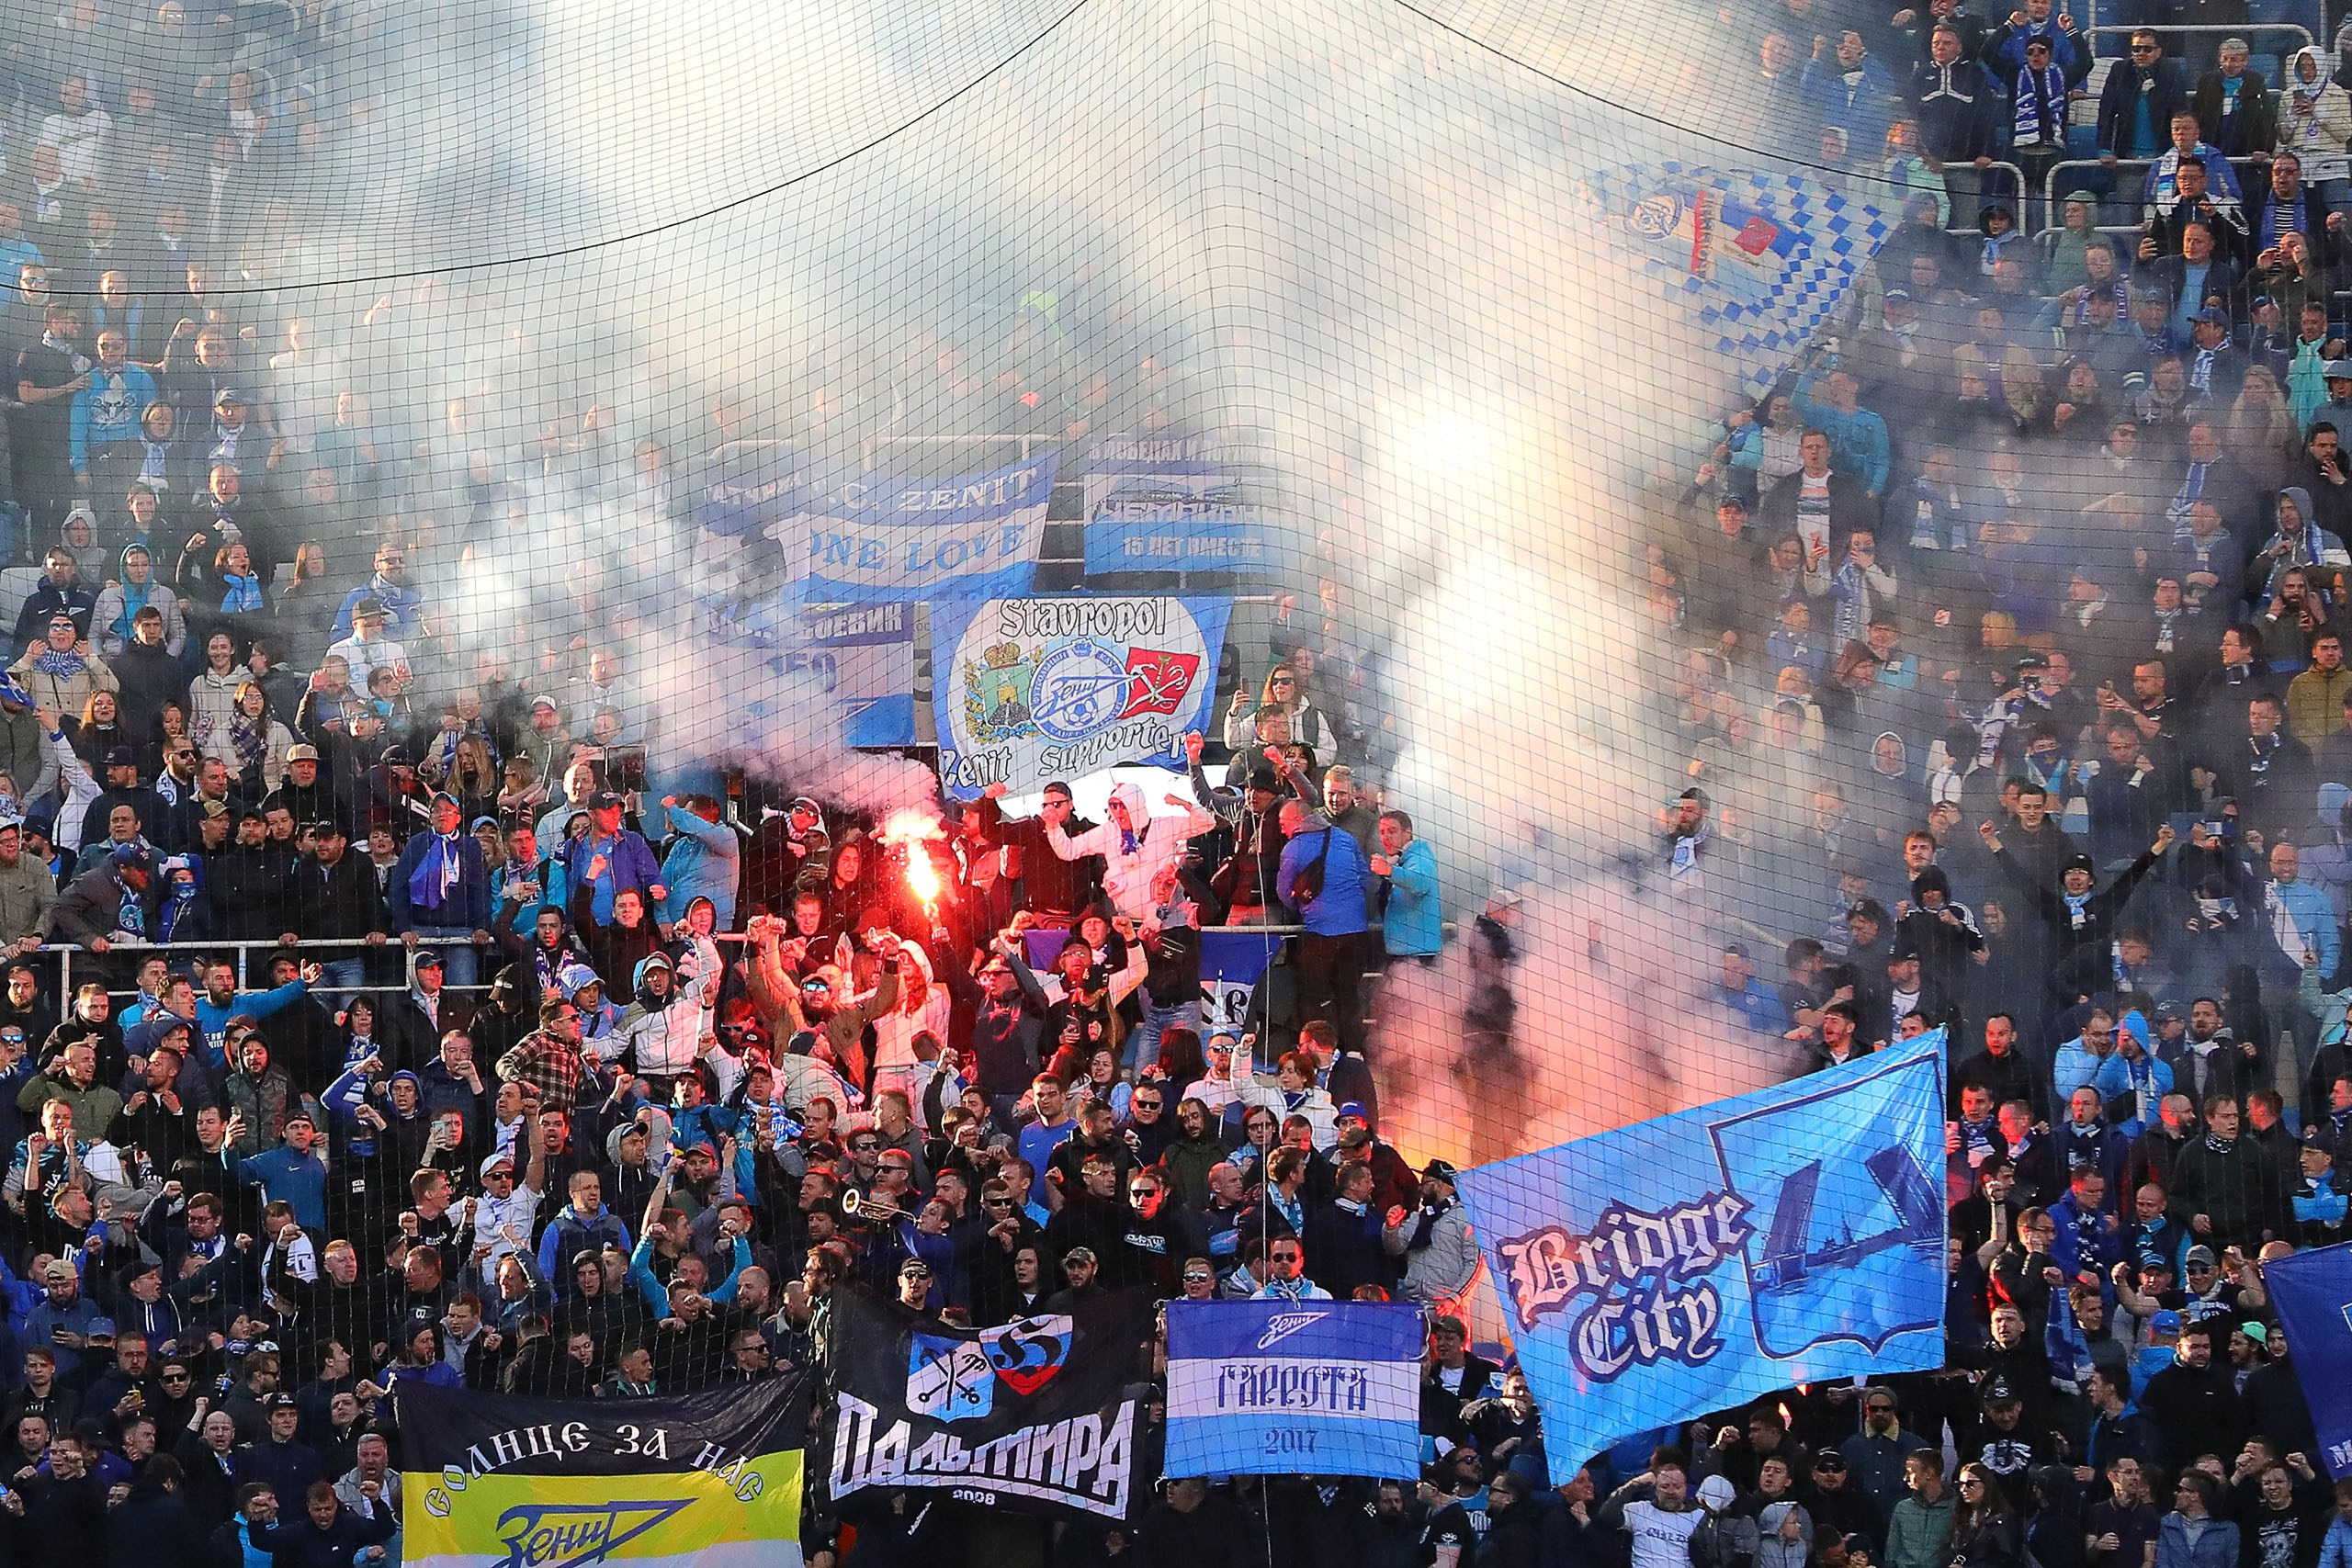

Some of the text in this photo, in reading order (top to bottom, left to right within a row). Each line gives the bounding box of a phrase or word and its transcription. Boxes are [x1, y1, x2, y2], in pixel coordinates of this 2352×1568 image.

[899, 467, 1038, 512] ZENIT
[905, 525, 1026, 571] LOVE
[1001, 597, 1167, 643] Stavropol
[942, 747, 1012, 788] Zenit
[1498, 1191, 1751, 1328] Bridge
[1573, 1282, 1724, 1378] City
[614, 1423, 670, 1461] ЗА
[689, 1439, 764, 1502] НАС
[1264, 1427, 1319, 1454] 2017
[952, 1489, 996, 1506] 2008
